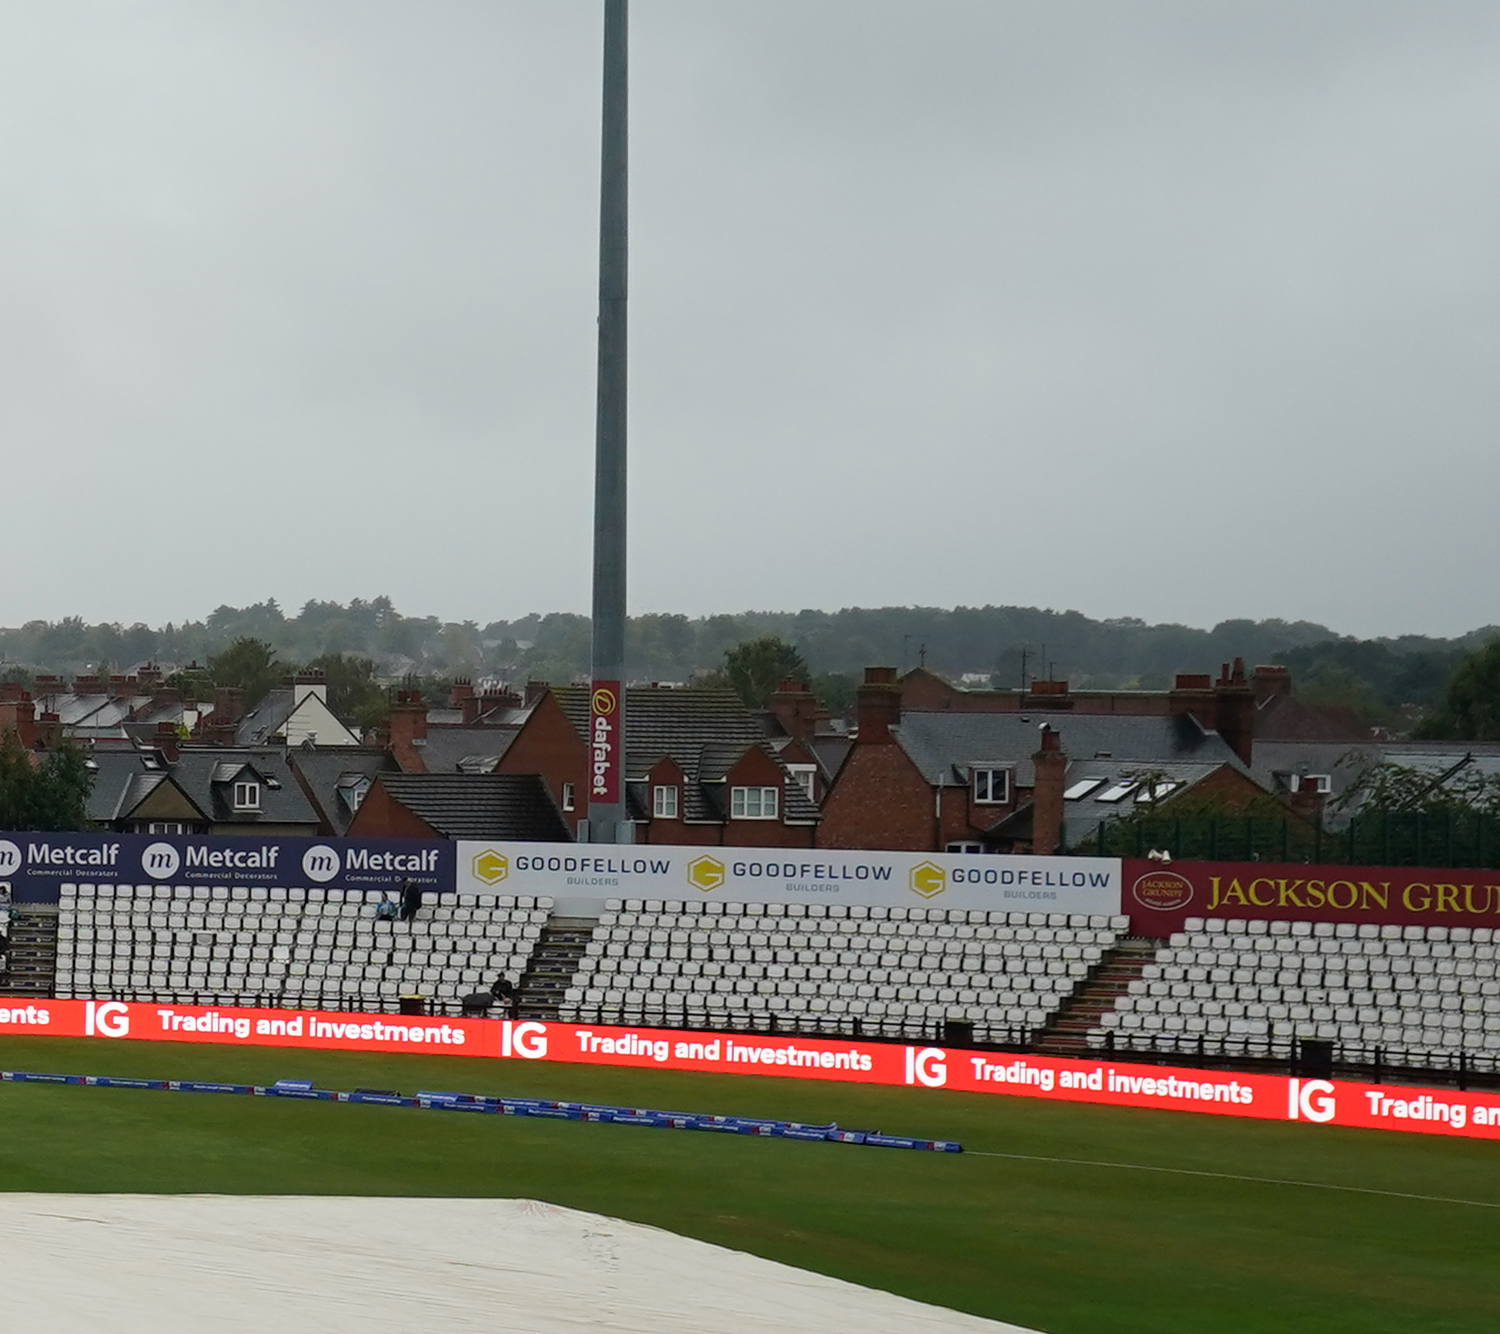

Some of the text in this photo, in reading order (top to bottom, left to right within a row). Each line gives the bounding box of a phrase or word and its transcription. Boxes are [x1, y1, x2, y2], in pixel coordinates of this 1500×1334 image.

[592, 717, 612, 795] dafabet
[27, 843, 120, 865] Metcalf
[185, 845, 280, 868] Metcalf
[346, 848, 439, 871] Metcalf
[27, 868, 118, 877] Commercial Decorators
[185, 871, 278, 880] Commercial Decorators
[516, 856, 671, 875] GOODFELLOW
[733, 862, 892, 881] GOODFELLOW
[345, 874, 392, 882] Commercial
[566, 876, 619, 886] BUILDERS
[785, 883, 840, 893] BUILDERS
[952, 868, 1110, 888] GOODFELLOW
[1003, 890, 1057, 900] BUILDERS
[1207, 877, 1390, 910] JACKSON
[85, 1001, 465, 1045] IG Trading and investments
[501, 1022, 872, 1071] IG Trading and investments
[905, 1048, 1253, 1104] IG Trading and investments
[1288, 1079, 1336, 1121] IG
[1365, 1091, 1467, 1129] Trading
